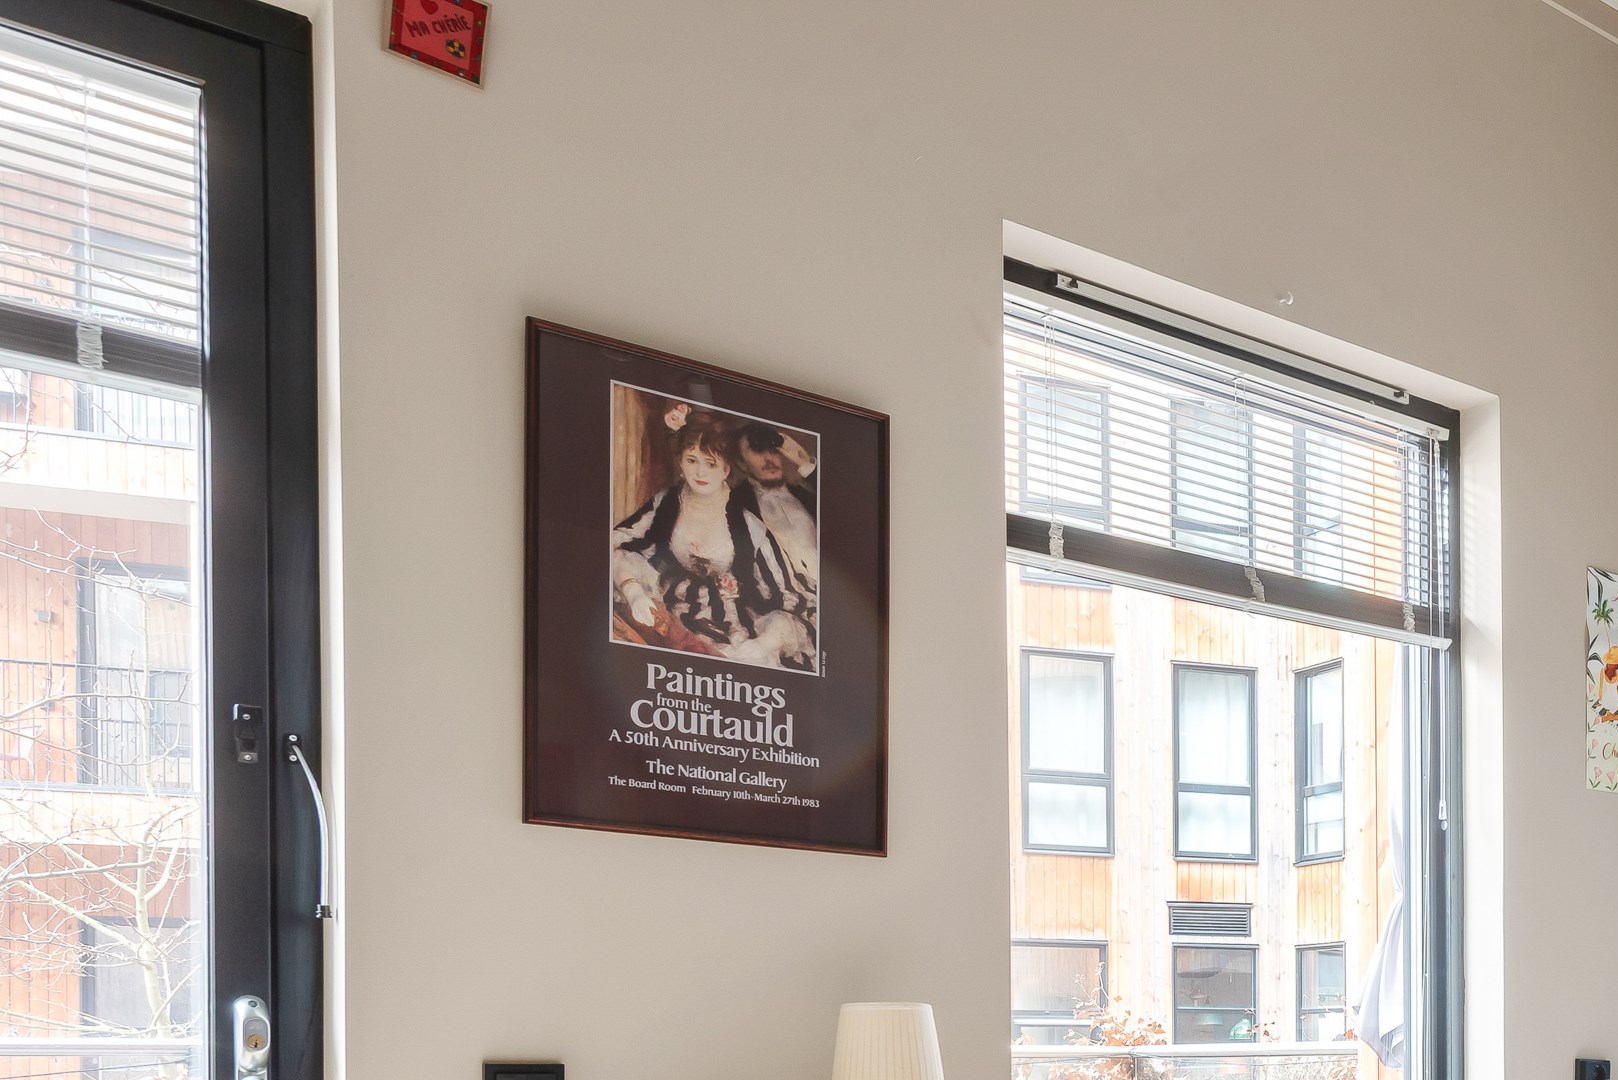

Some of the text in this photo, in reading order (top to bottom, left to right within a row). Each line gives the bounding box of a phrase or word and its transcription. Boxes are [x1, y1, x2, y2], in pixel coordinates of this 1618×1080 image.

[405, 21, 430, 38] MA
[646, 663, 786, 717] Paintings
[657, 693, 712, 713] from the
[630, 699, 794, 748] Courtauld
[608, 729, 820, 767] A 50th Anniversary Exhibition
[608, 776, 628, 787] The
[628, 778, 657, 790] Board
[658, 781, 686, 793] Room
[692, 785, 731, 800] February
[782, 795, 801, 806] 27th
[802, 798, 820, 808] 1983
[646, 759, 787, 793] The National Gallery
